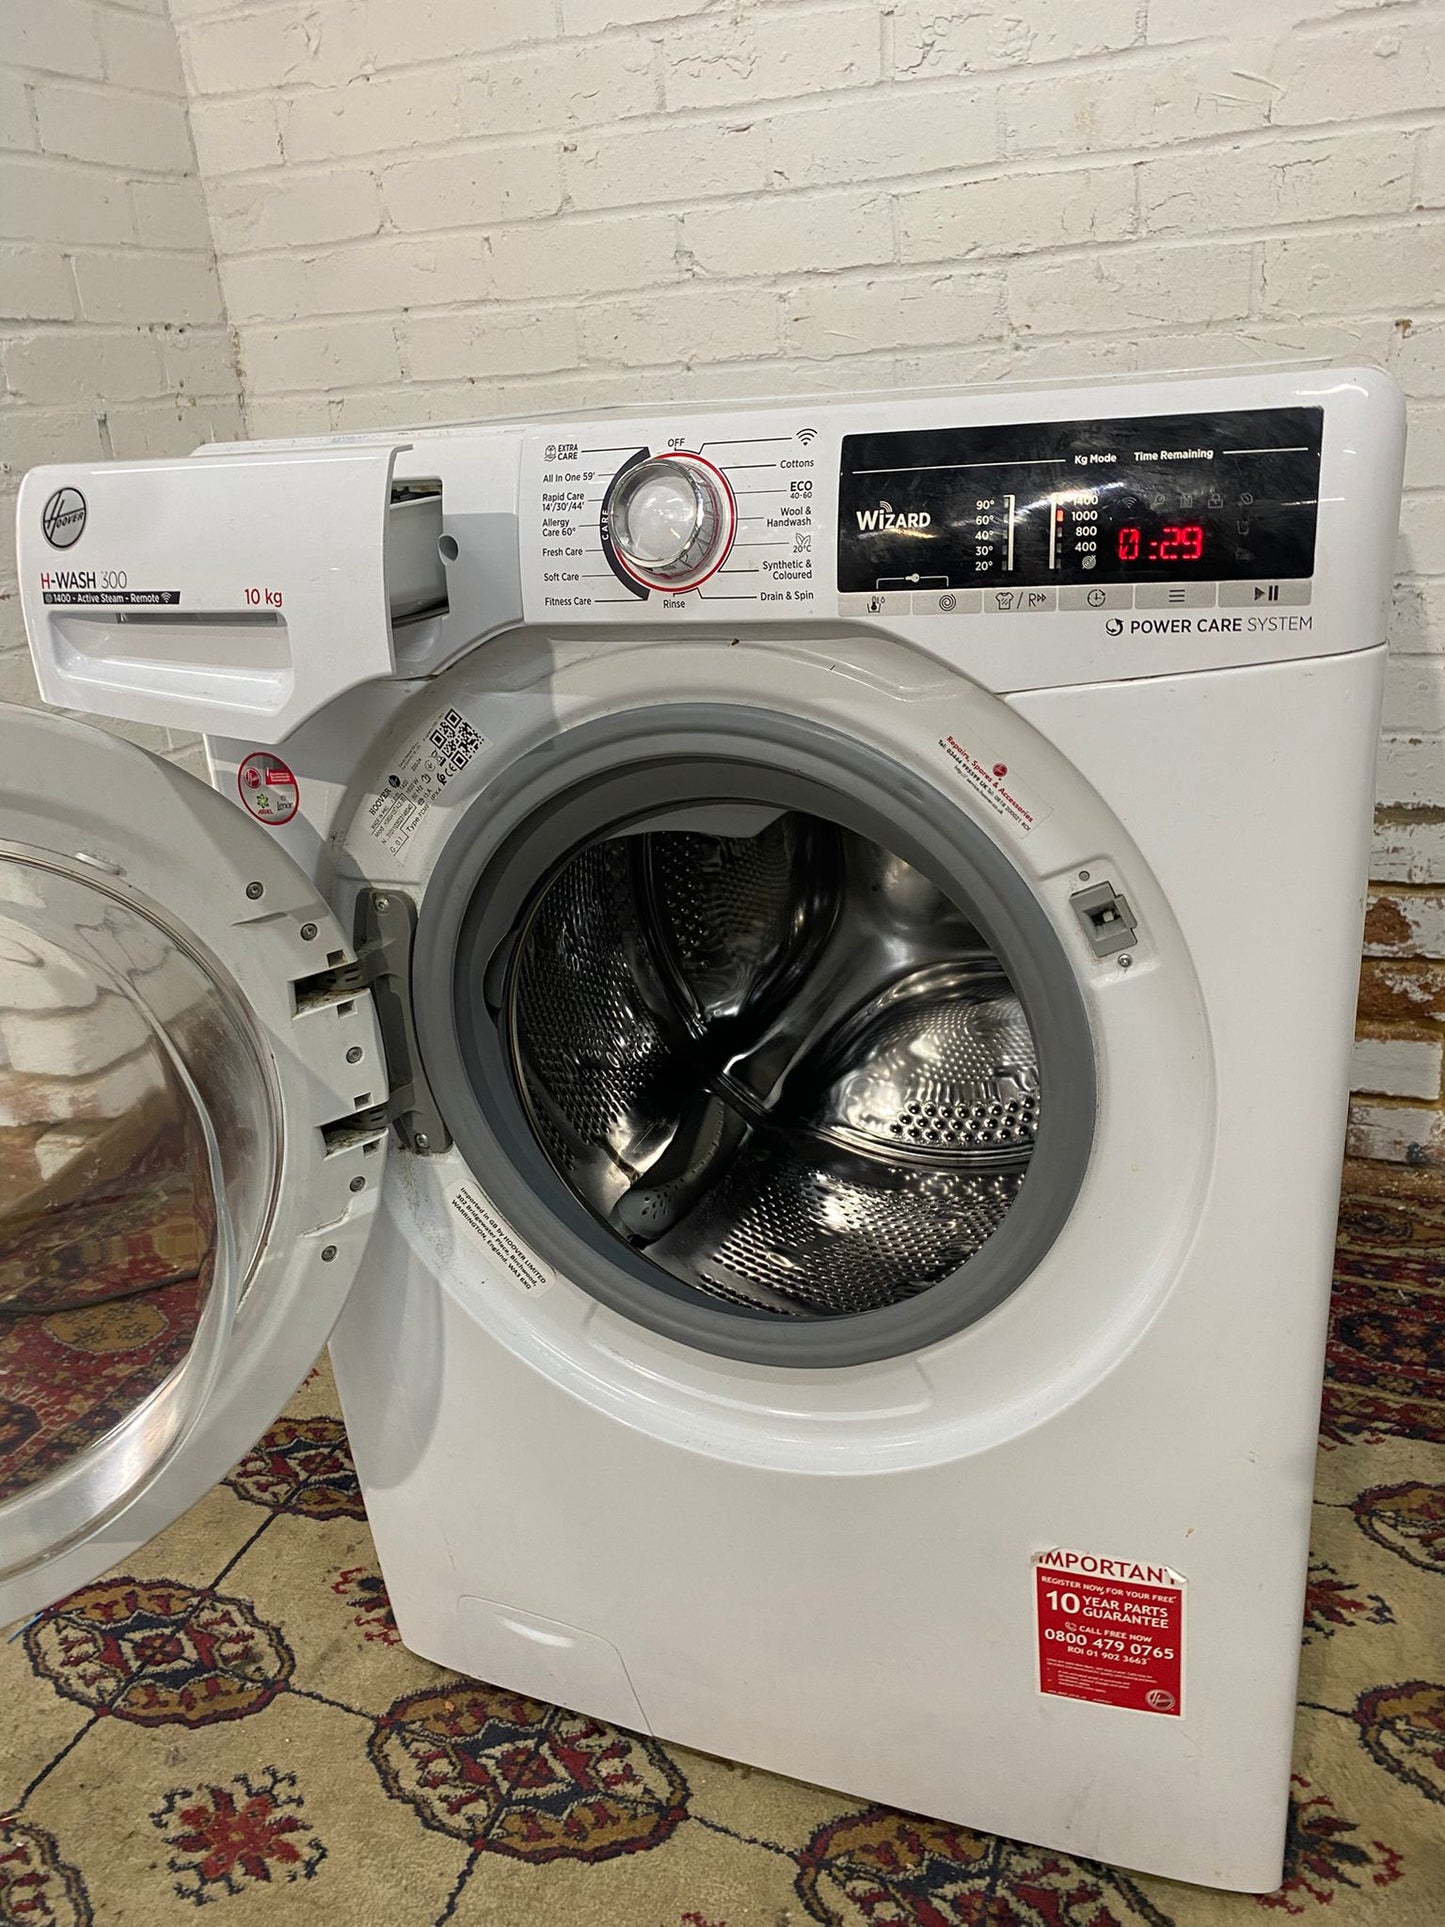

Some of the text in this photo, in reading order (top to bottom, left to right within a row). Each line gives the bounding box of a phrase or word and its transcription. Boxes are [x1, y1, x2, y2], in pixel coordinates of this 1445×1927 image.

[667, 438, 685, 447] OFF
[558, 444, 578, 452] EXTRA
[558, 452, 578, 460] CARE
[1074, 453, 1117, 465] Kg Mode
[1134, 449, 1214, 461] Time Remaining
[780, 460, 814, 468] Cottons
[542, 472, 596, 483] All In One 59'
[790, 480, 812, 492] ECO
[542, 492, 584, 502] Rapid Care
[976, 500, 994, 510] 90°
[780, 506, 812, 516] Wool &
[1072, 511, 1098, 521] 1000
[542, 518, 570, 528] Allergy
[766, 517, 812, 527] Handwash
[975, 515, 994, 525] 60°
[542, 527, 576, 536] Care 60°
[975, 530, 994, 540] 40°
[1076, 526, 1098, 536] 800
[542, 548, 582, 556] Fresh Care
[975, 546, 994, 556] 30°
[1075, 542, 1096, 552] 400
[762, 559, 812, 571] Synthetic &
[975, 561, 993, 571] 20°
[40, 571, 128, 589] H-WASH 300
[544, 572, 580, 581] Soft Care
[773, 570, 812, 580] Coloured
[53, 594, 71, 602] 1400
[78, 594, 99, 602] Active
[100, 594, 124, 602] Steam
[130, 594, 160, 602] Remote
[244, 588, 282, 608] 10 kg
[760, 590, 814, 601] Drain & Spin
[545, 596, 592, 606] Fitness Care
[663, 600, 686, 608] Rinse
[1130, 616, 1313, 634] POWER CARE SYSTEM
[938, 739, 946, 749] Tel:
[980, 780, 988, 790] UK
[946, 736, 970, 762] Repairs,
[972, 760, 992, 782] Spares
[1000, 788, 1034, 822] Accessories
[368, 788, 392, 816] HOOVER
[406, 816, 420, 832] Type
[456, 1194, 538, 1286] 302 Bridgewater Place, Birchwood,
[460, 1187, 484, 1214] Imported
[490, 1220, 498, 1228] GB
[497, 1228, 504, 1237] by
[504, 1236, 526, 1260] HOOVER
[524, 1260, 546, 1284] LIMITED
[452, 1200, 487, 1240] WARRINGTON,
[508, 1264, 520, 1278] WA3
[520, 1278, 531, 1290] 6XG
[1039, 1552, 1175, 1584] IMPORTAN
[1042, 1576, 1081, 1588] REGISTER
[1106, 1588, 1124, 1596] FOR
[1126, 1590, 1150, 1600] YOUR
[1046, 1590, 1168, 1618] 10 YEAR PARTS
[1082, 1607, 1169, 1628] GUARANTEE
[1079, 1626, 1152, 1642] CALL FREE NOW
[1044, 1628, 1174, 1660] 0800 479 0765
[1067, 1646, 1084, 1654] ROI
[1086, 1649, 1098, 1657] 01
[1101, 1652, 1120, 1661] 902
